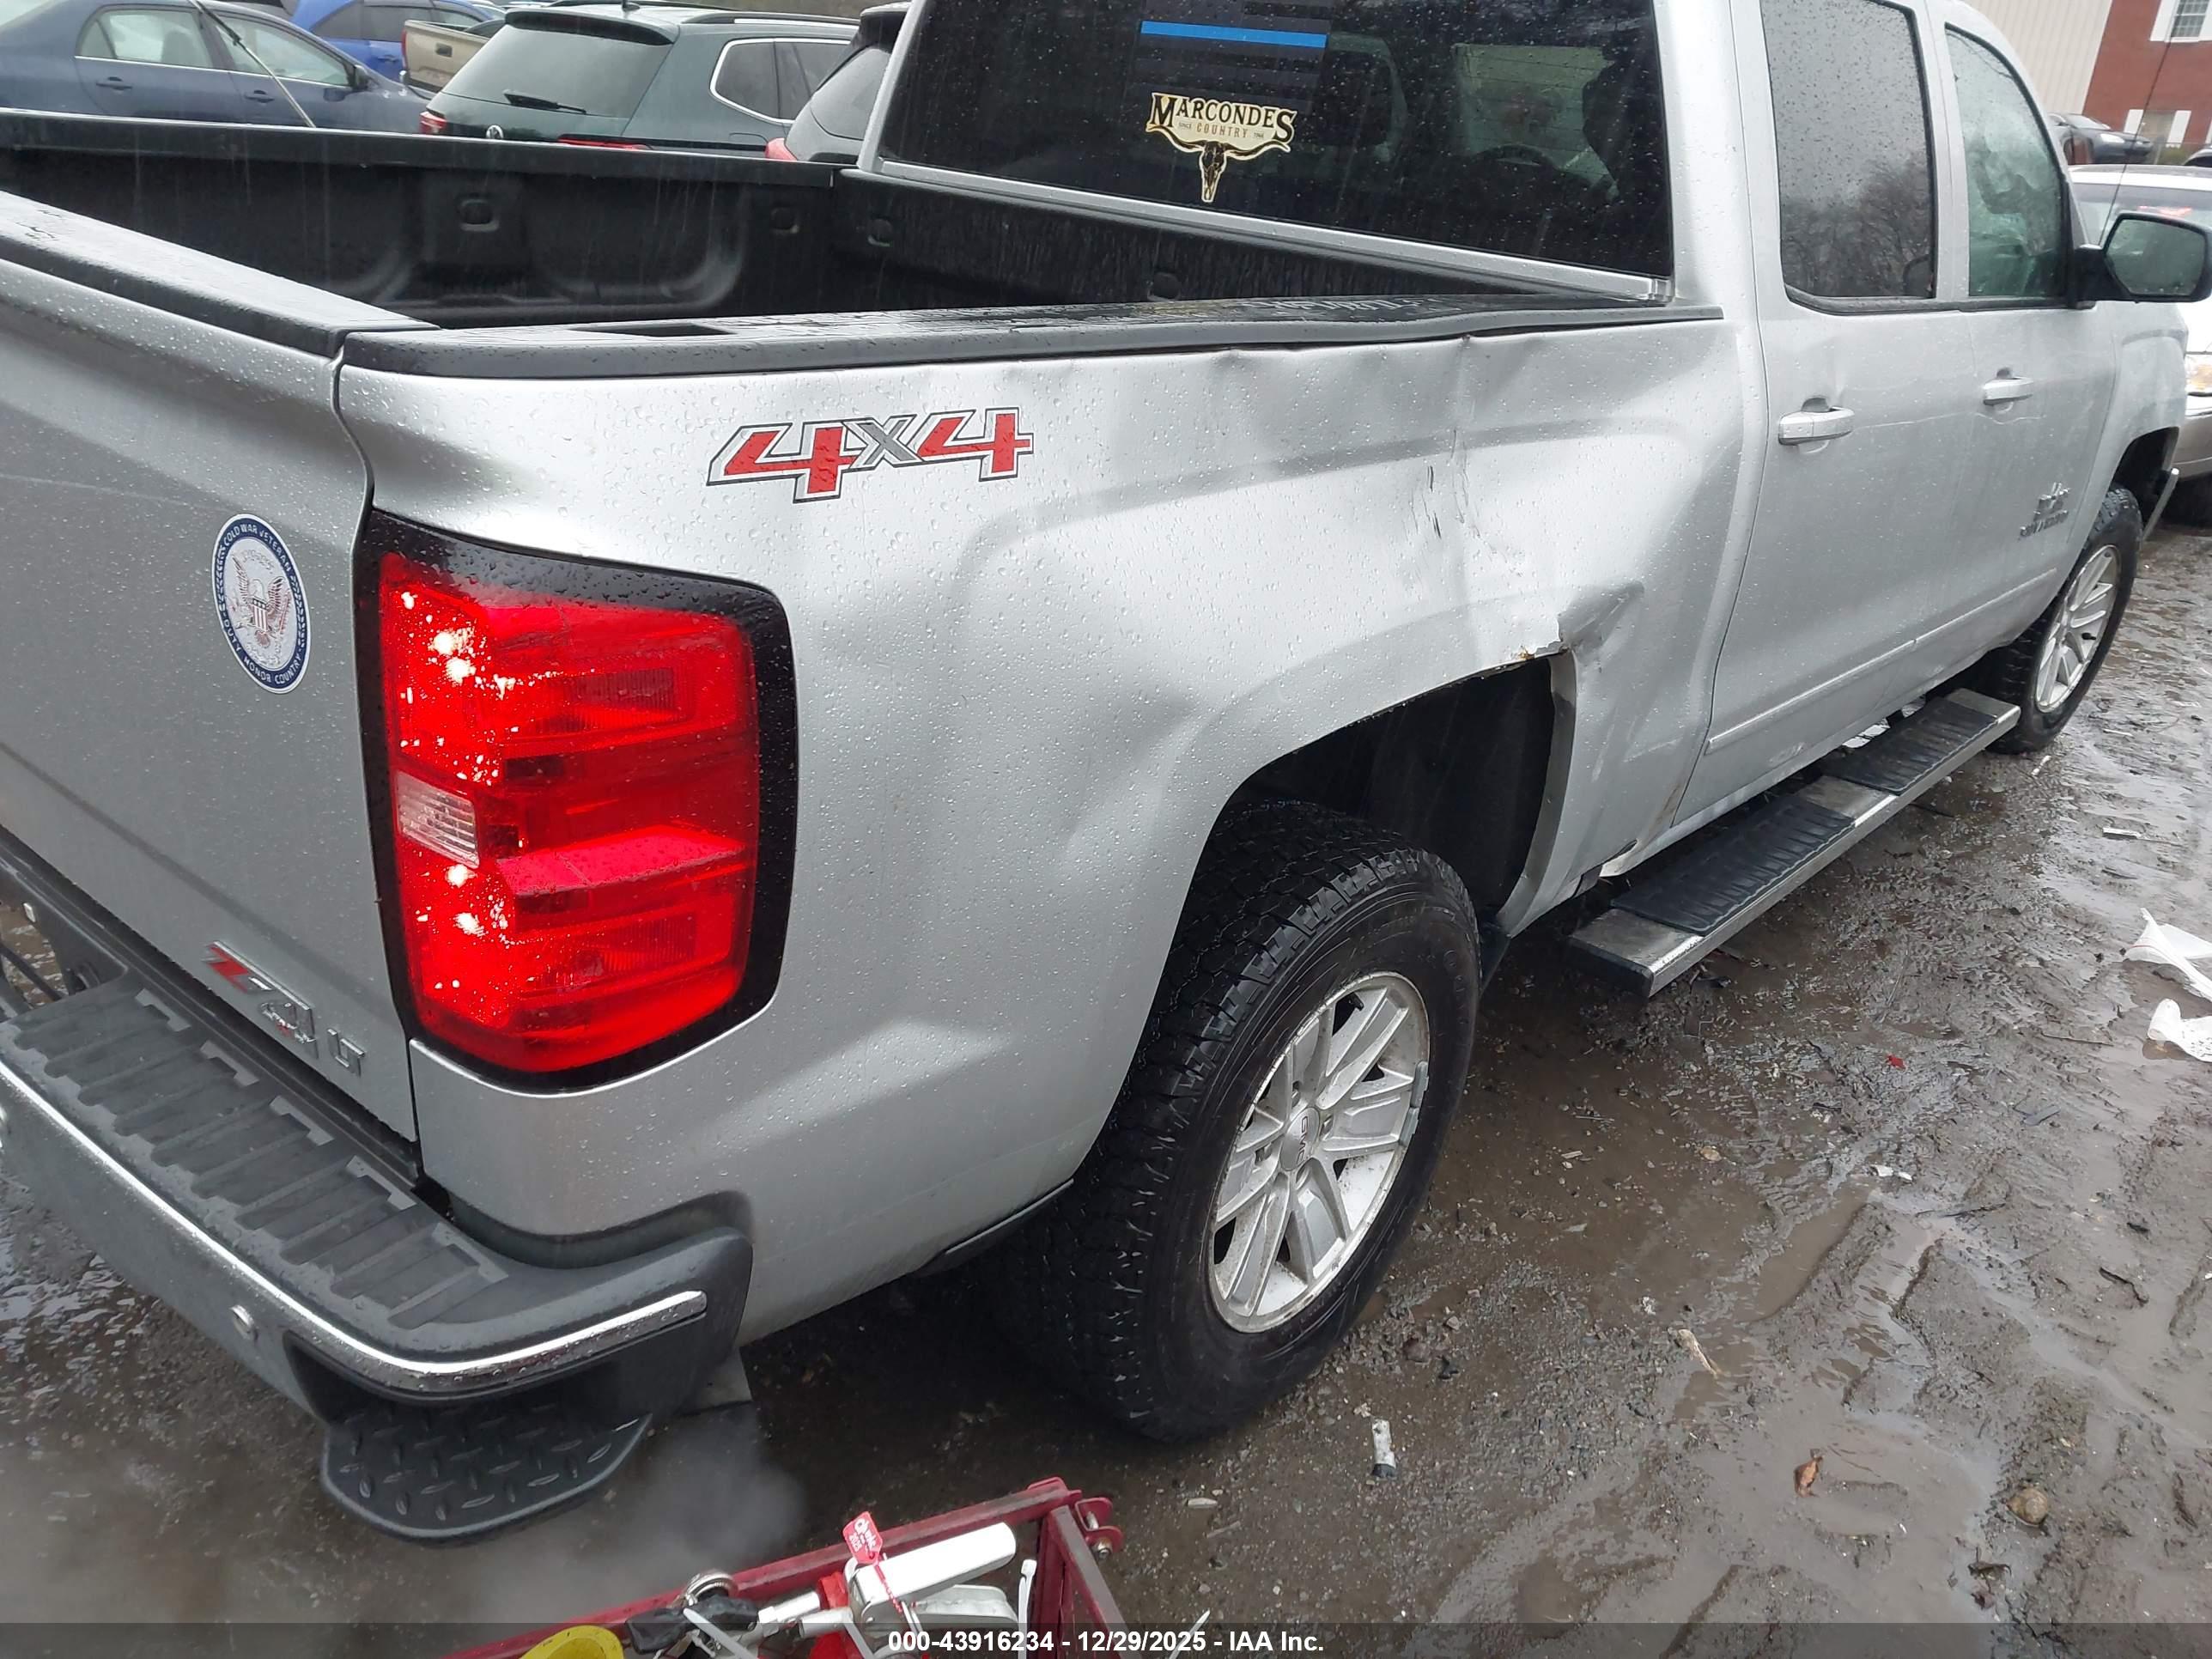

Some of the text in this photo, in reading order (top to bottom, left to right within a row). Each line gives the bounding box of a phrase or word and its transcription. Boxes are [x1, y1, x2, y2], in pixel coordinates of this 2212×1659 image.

[1149, 94, 1296, 142] MARCONDES
[1196, 123, 1249, 137] COUNTRY
[223, 524, 291, 572] COLD WAR VETERAN
[223, 618, 302, 684] DUTY HONOR COUNTRY
[1297, 1115, 1309, 1165] GMC
